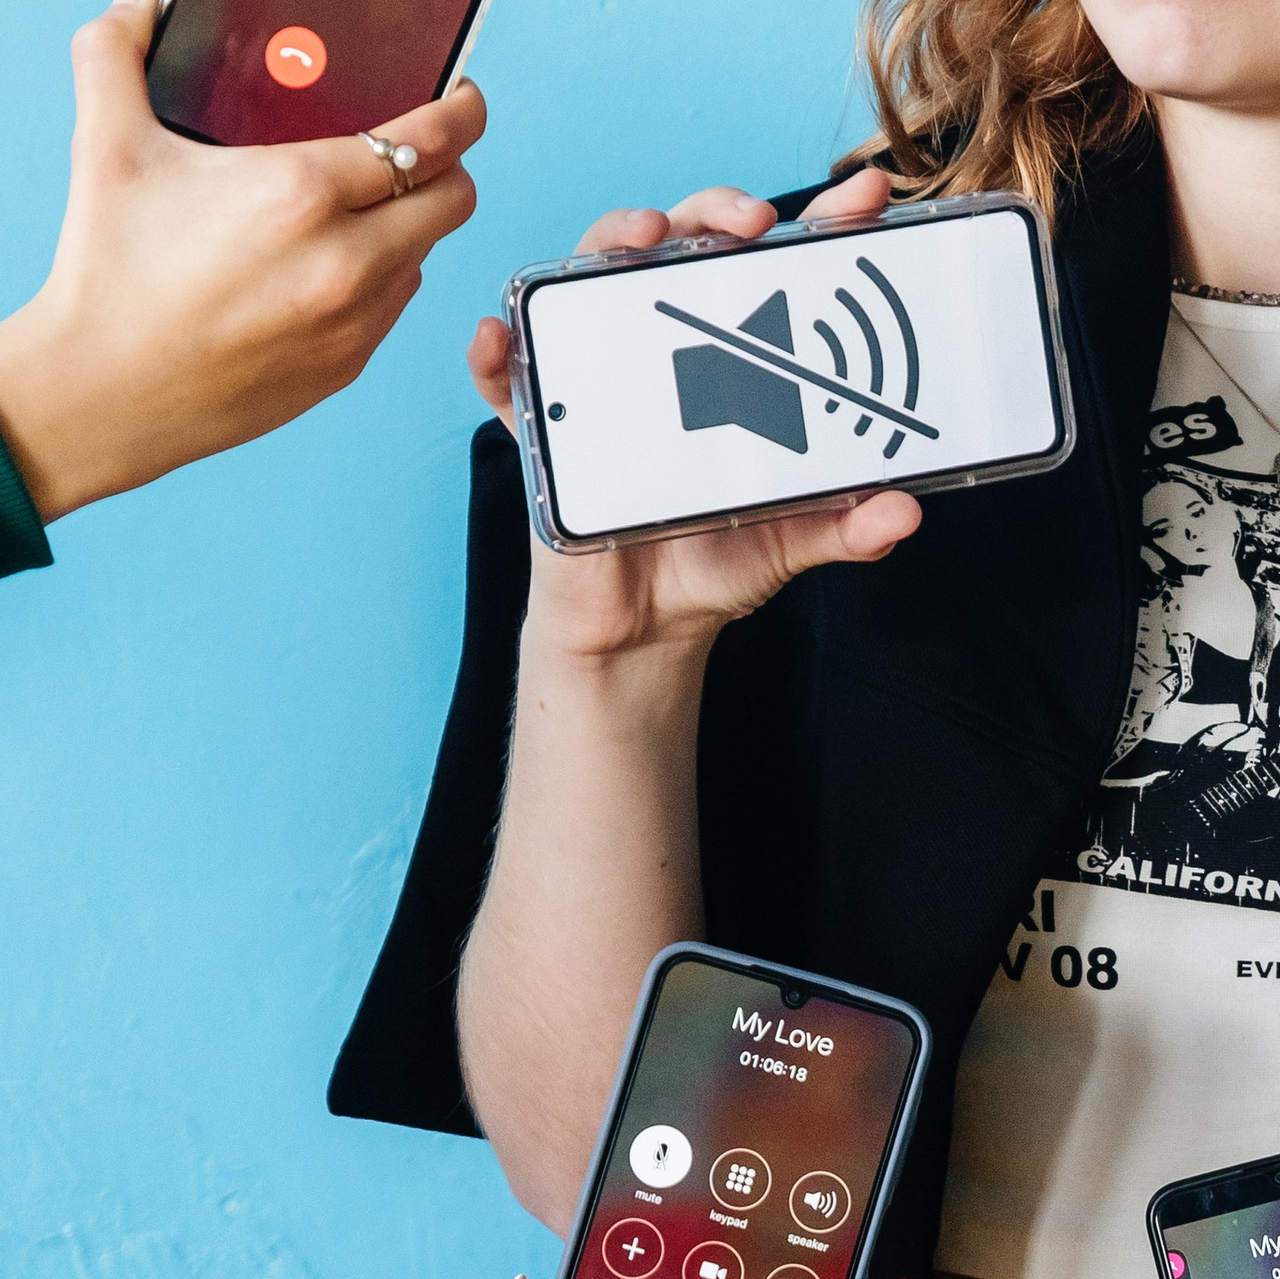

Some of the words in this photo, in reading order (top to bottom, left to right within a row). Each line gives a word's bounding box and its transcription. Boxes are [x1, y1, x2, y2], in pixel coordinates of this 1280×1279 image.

[1051, 945, 1118, 990] 08
[732, 1007, 772, 1042] My
[775, 1019, 834, 1056] Love
[740, 1051, 808, 1082] 01:06:18
[635, 1189, 663, 1205] mute
[709, 1209, 748, 1230] keypad
[787, 1233, 829, 1253] speaker
[1249, 1234, 1280, 1258] My
